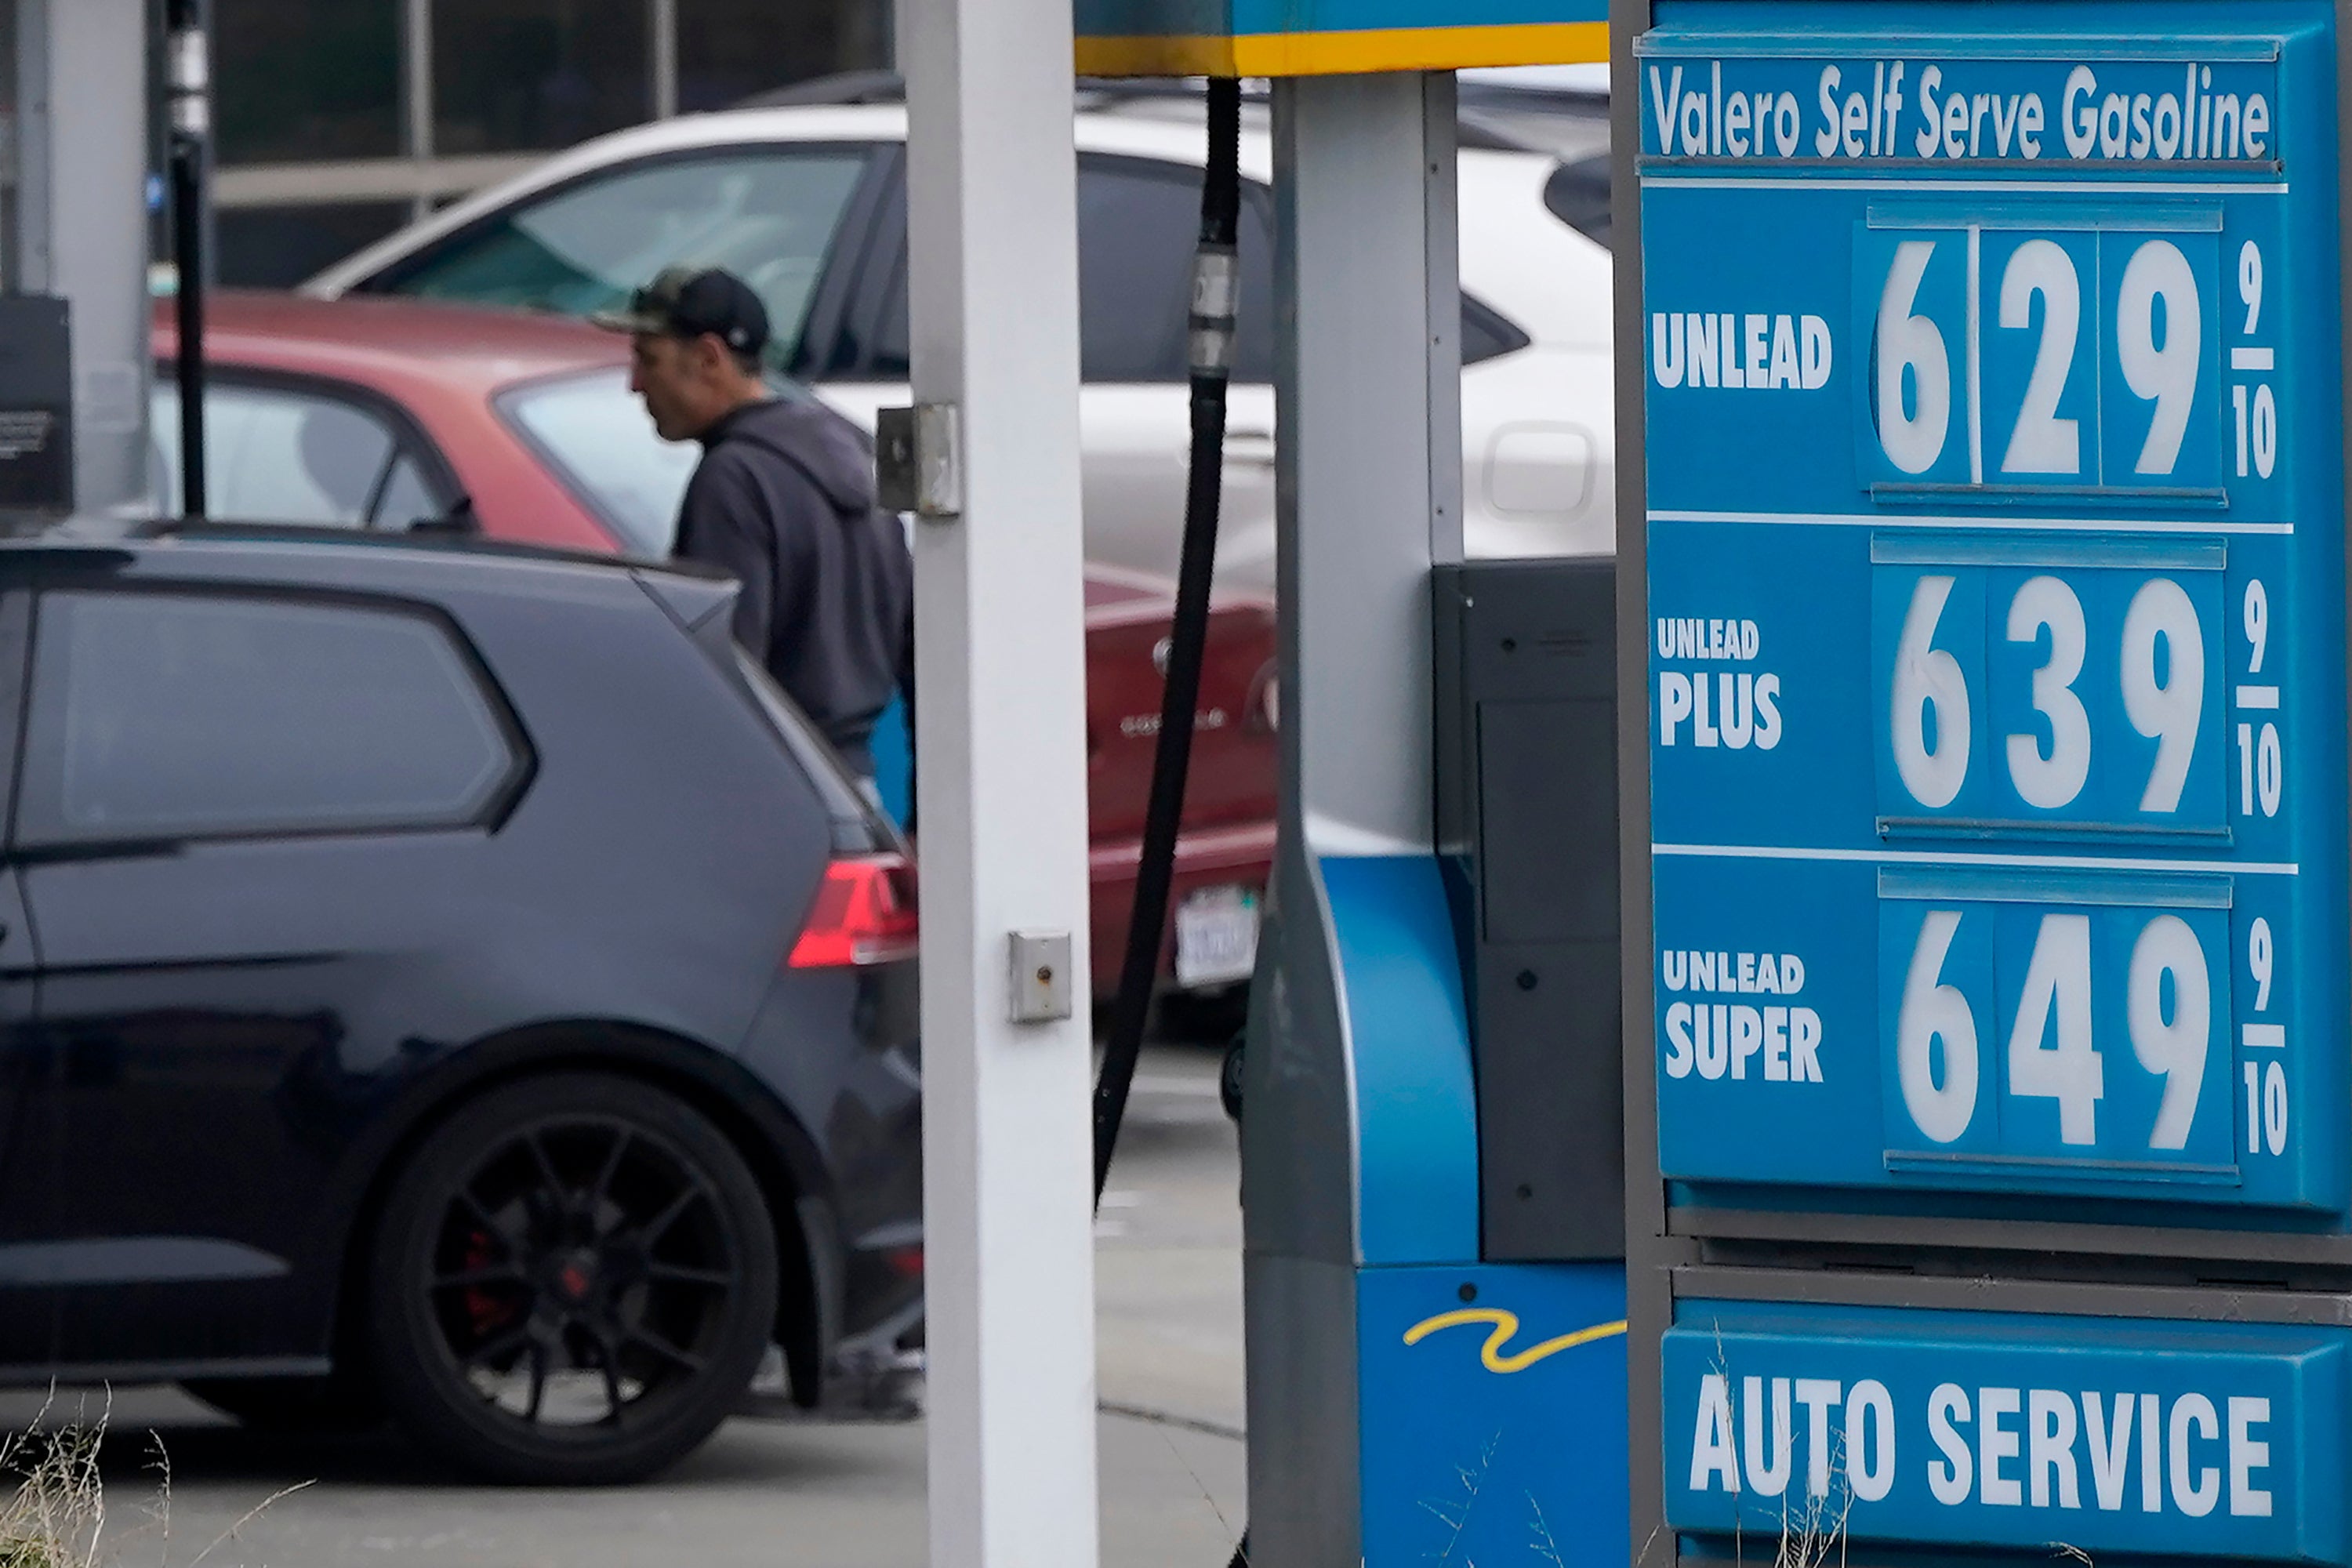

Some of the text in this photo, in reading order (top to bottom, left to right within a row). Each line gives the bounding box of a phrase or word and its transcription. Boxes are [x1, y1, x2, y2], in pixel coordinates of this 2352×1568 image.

[1649, 60, 2270, 161] Valero Self Serve Gasoline
[2238, 240, 2263, 335] 9
[1652, 313, 1833, 390] UNLEAD
[1878, 240, 2201, 474] 629
[2232, 383, 2277, 480] 10
[1657, 618, 1760, 660] UNLEAD
[2243, 579, 2268, 673] 9
[1658, 672, 1783, 750] PLUS
[1890, 575, 2205, 812] 639
[2237, 723, 2282, 818] 10
[1663, 950, 1806, 995] UNLEAD
[2249, 916, 2274, 1011] 9
[1664, 1002, 1824, 1083] SUPER
[1896, 911, 2211, 1150] 649
[2243, 1060, 2288, 1156] 10
[1689, 1373, 2274, 1518] AUTO SERVICE
